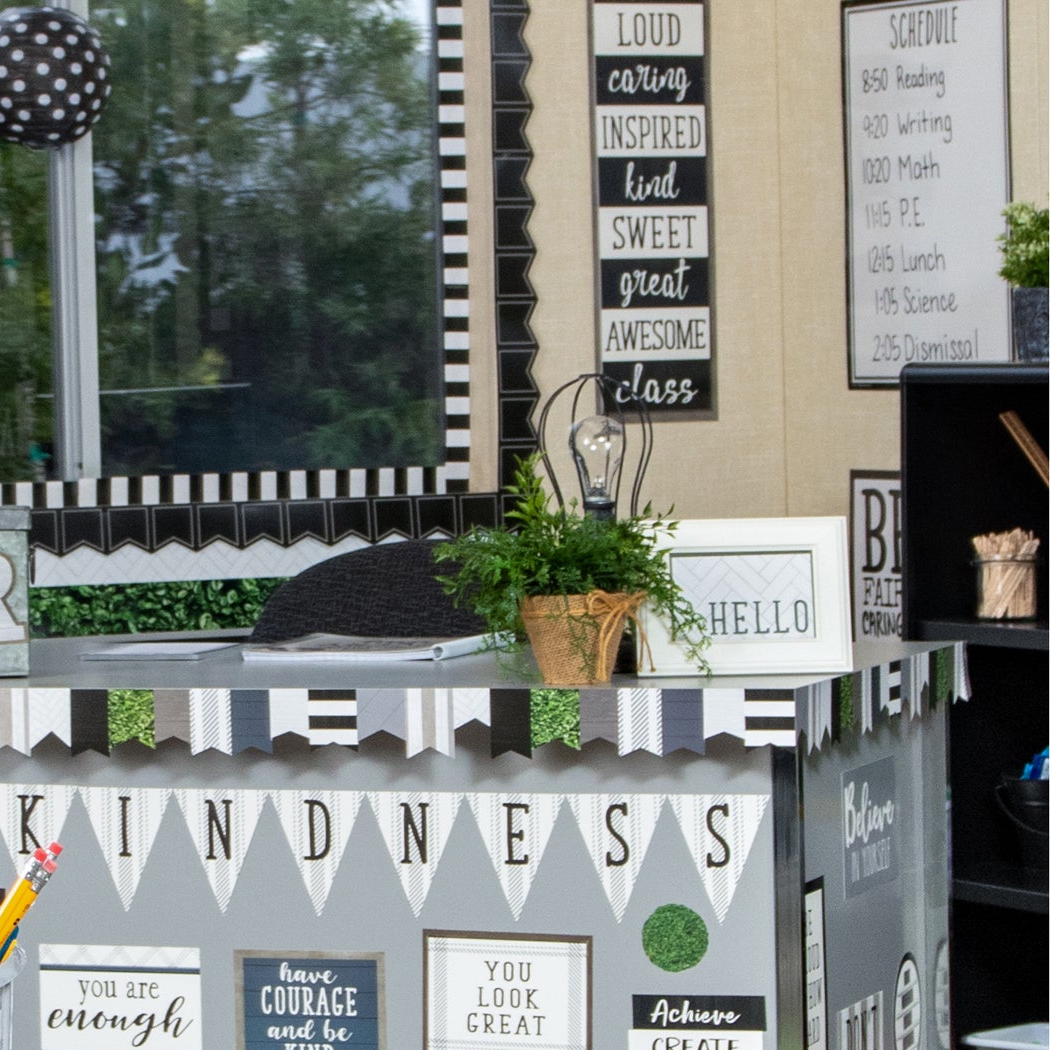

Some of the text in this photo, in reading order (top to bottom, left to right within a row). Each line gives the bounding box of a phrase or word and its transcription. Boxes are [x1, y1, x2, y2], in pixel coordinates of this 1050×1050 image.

[617, 12, 681, 46] LOUD
[890, 6, 958, 50] SCHEDULE
[608, 64, 691, 103] caring
[862, 63, 945, 98] 8:50 Reading
[602, 115, 701, 150] INSPIRED
[863, 109, 953, 144] 9:20 Writing
[625, 160, 680, 201] kind
[898, 150, 941, 181] Math
[899, 196, 925, 228] P.E.
[612, 215, 697, 250] SWEET
[868, 243, 947, 274] 12:15 Lunch
[620, 257, 691, 308] great
[875, 286, 959, 316] 1:05 Science
[605, 319, 707, 352] AWESOME
[872, 327, 980, 362] 2:05 Dismissal
[615, 363, 698, 404] class
[709, 599, 810, 636] HELLO
[17, 794, 731, 869] KINDNESS
[844, 781, 895, 849] Believe
[279, 961, 338, 984] have
[484, 960, 532, 983] YOU
[78, 979, 160, 1006] you are
[261, 985, 358, 1016] COURAGE
[477, 986, 540, 1010] LOOK
[47, 996, 194, 1048] enough
[466, 1012, 546, 1036] GREAT
[650, 999, 742, 1027] Achieve
[267, 1019, 353, 1042] and be
